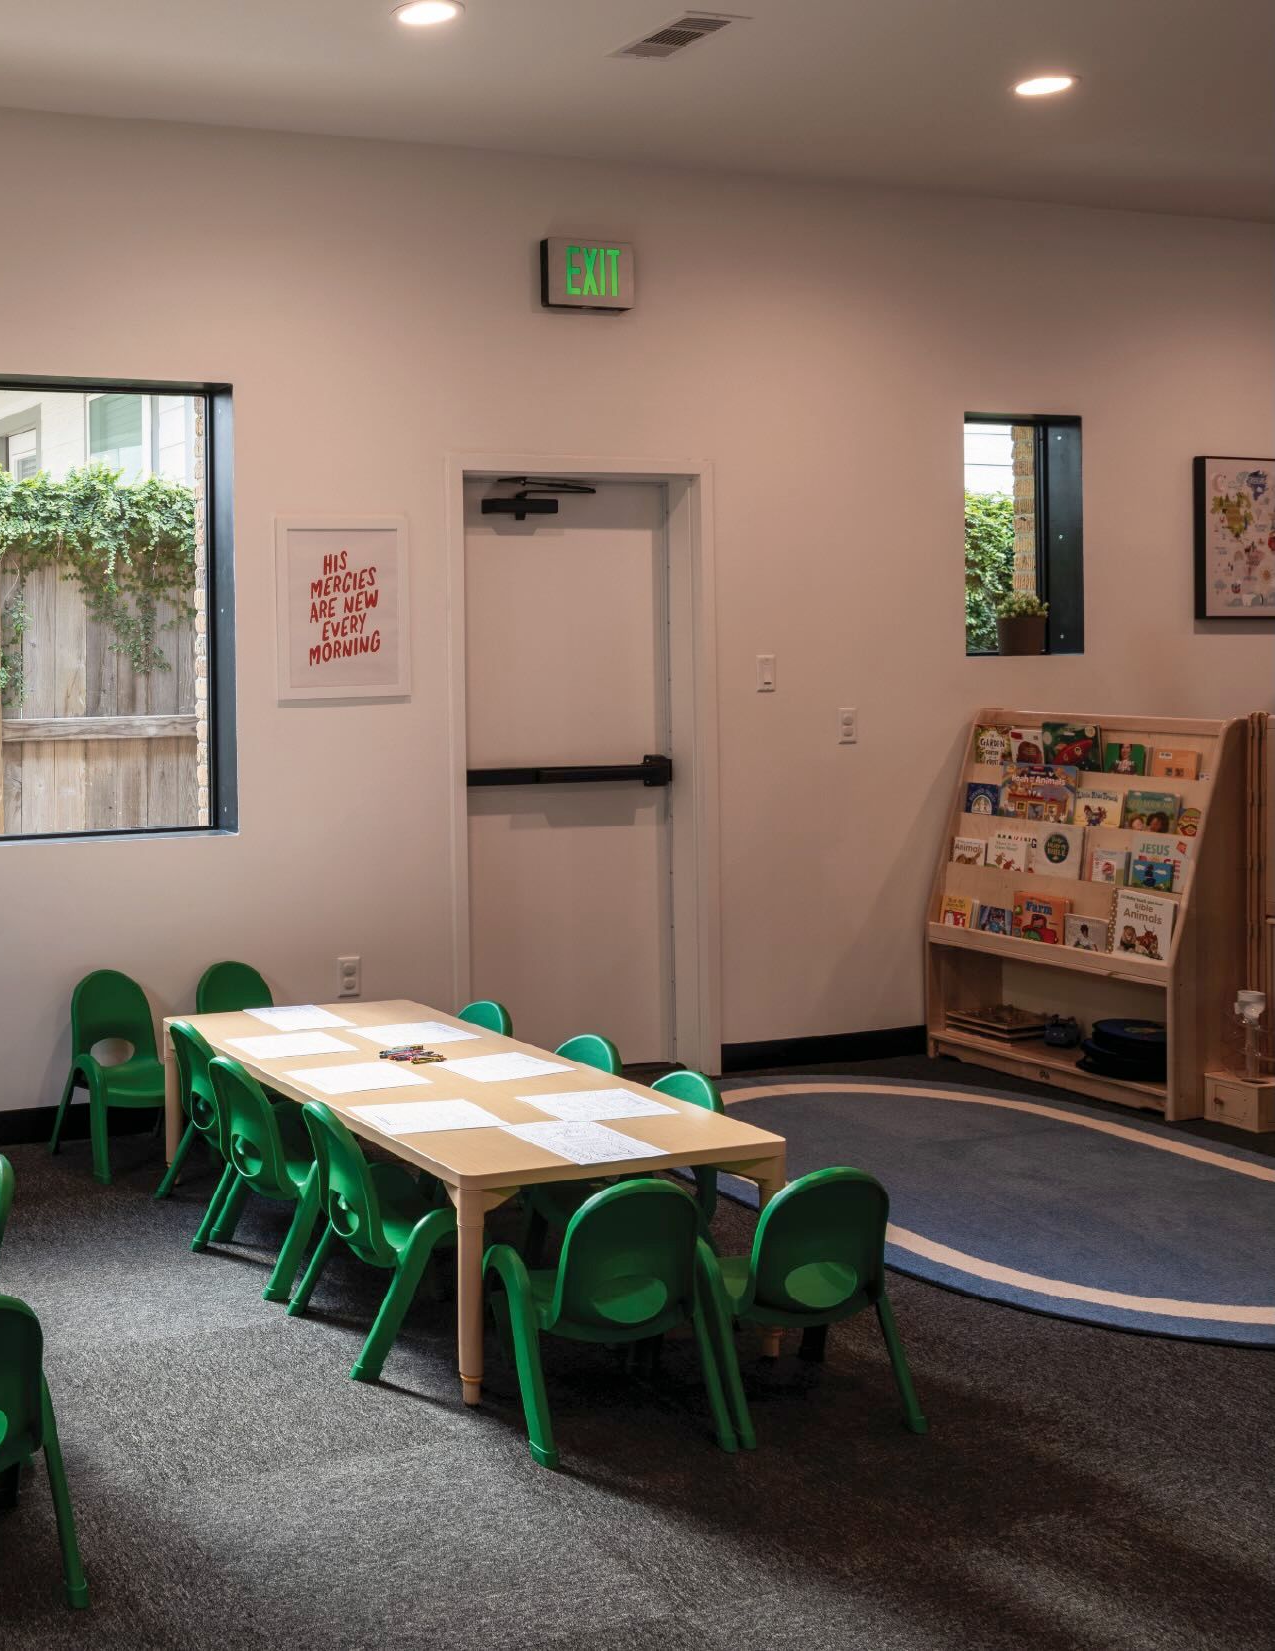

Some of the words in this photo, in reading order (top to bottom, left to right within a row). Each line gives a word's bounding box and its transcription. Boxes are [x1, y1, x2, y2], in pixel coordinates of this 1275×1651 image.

[566, 246, 620, 297] EXIT
[323, 550, 348, 575] HIS
[310, 566, 377, 599] MERCIES
[310, 597, 337, 624] ARE
[344, 589, 379, 613] NEW
[322, 612, 367, 642] EVERY
[309, 630, 381, 667] MORNING
[980, 738, 1005, 748] GARDEN
[1139, 842, 1171, 856] JESUS
[1025, 900, 1053, 916] Farm
[1123, 907, 1163, 925] Animals
[1134, 902, 1154, 913] Bible
